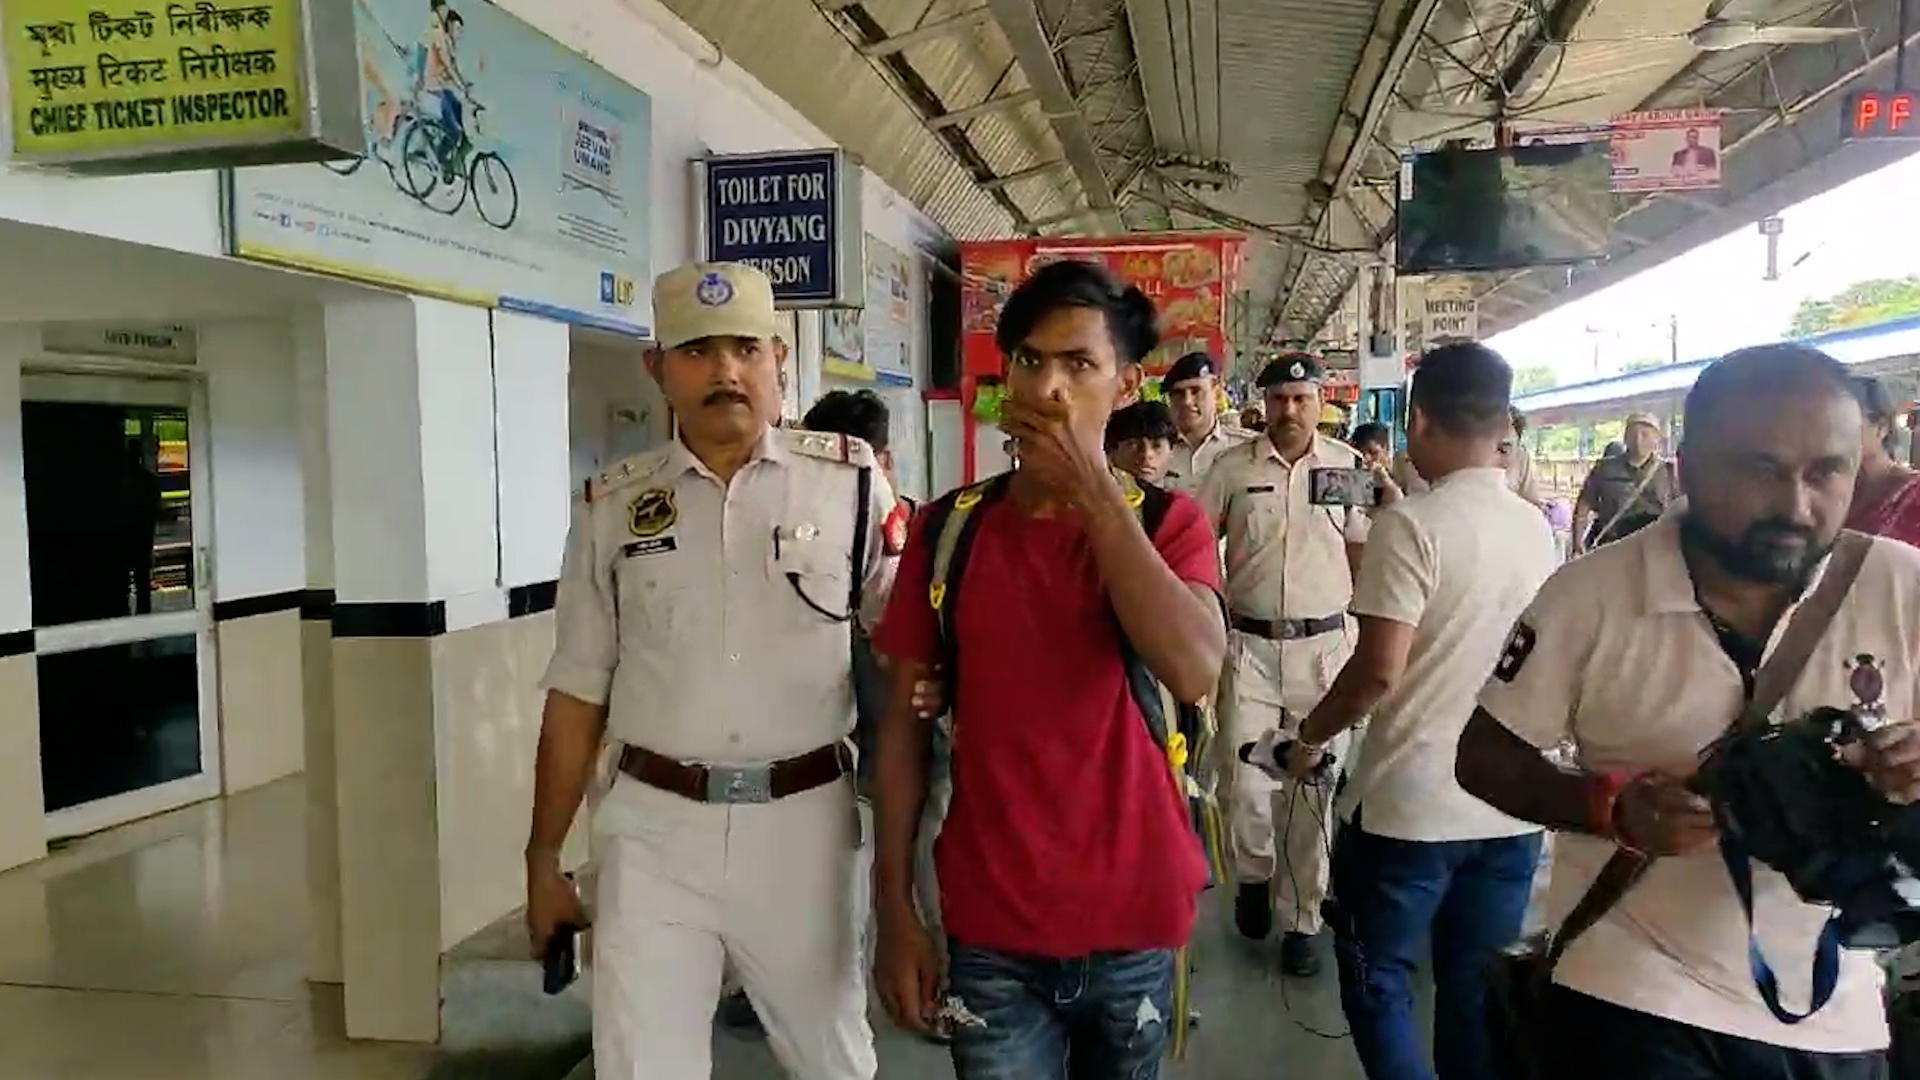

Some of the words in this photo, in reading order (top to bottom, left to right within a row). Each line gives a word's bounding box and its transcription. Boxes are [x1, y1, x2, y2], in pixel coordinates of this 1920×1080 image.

[29, 65, 86, 101] मुख्य
[97, 52, 167, 89] टिकट
[178, 43, 277, 81] निरीक्षक
[30, 103, 87, 136] CHIEF
[94, 97, 165, 131] TICKET
[171, 87, 289, 125] INSPECTOR
[718, 175, 782, 206] TOILET
[787, 172, 826, 201] FOR
[723, 213, 827, 247] DIVYANG
[1425, 298, 1475, 314] MEETING
[1433, 316, 1467, 332] POINT
